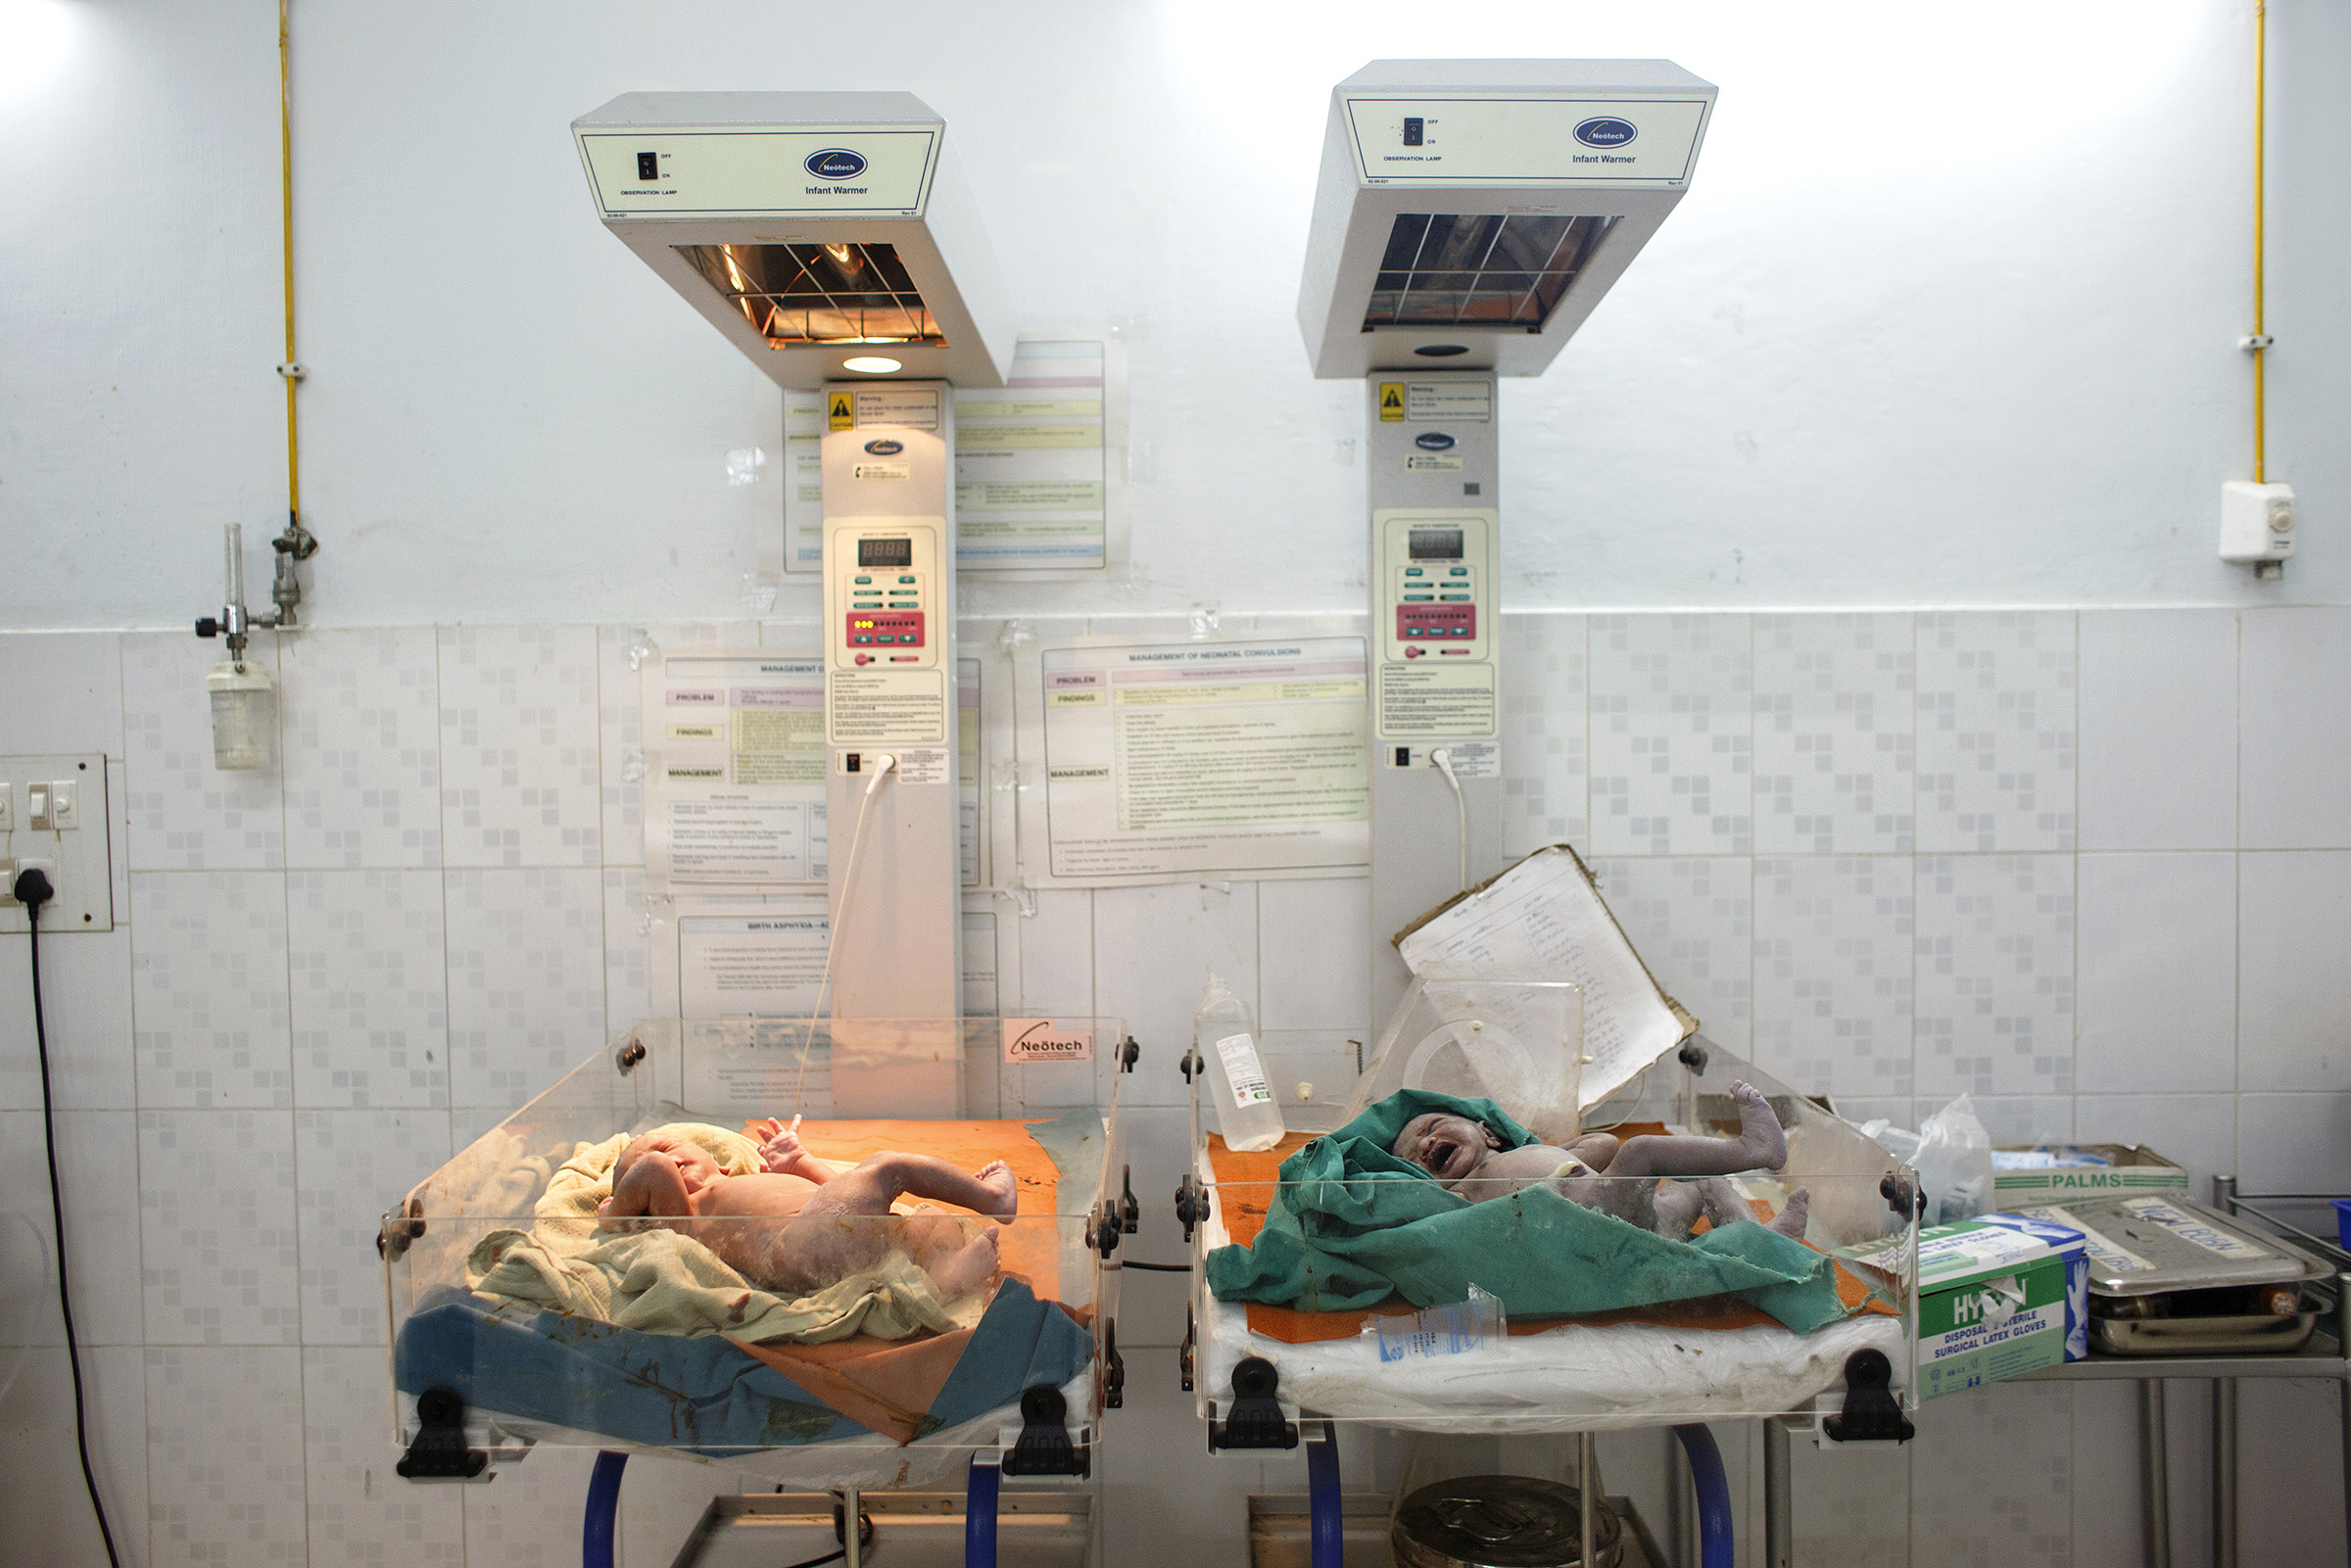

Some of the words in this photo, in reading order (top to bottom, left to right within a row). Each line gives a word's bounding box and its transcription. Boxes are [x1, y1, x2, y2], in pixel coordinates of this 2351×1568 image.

[1572, 154, 1599, 163] Infant
[1601, 155, 1636, 163] Warmer
[805, 186, 832, 194] Infant
[1129, 653, 1185, 662] MANAGEMENT
[1200, 651, 1242, 659] NEONATAL
[1244, 648, 1301, 658] CONVULSIONS
[1050, 769, 1109, 778] MANAGEMENT
[1021, 1040, 1082, 1052] Neötech
[2052, 1174, 2122, 1188] PALMS
[1934, 1339, 1980, 1358] SURGICAL
[1983, 1330, 2010, 1345] LATEX
[2013, 1320, 2046, 1337] GLOVES
